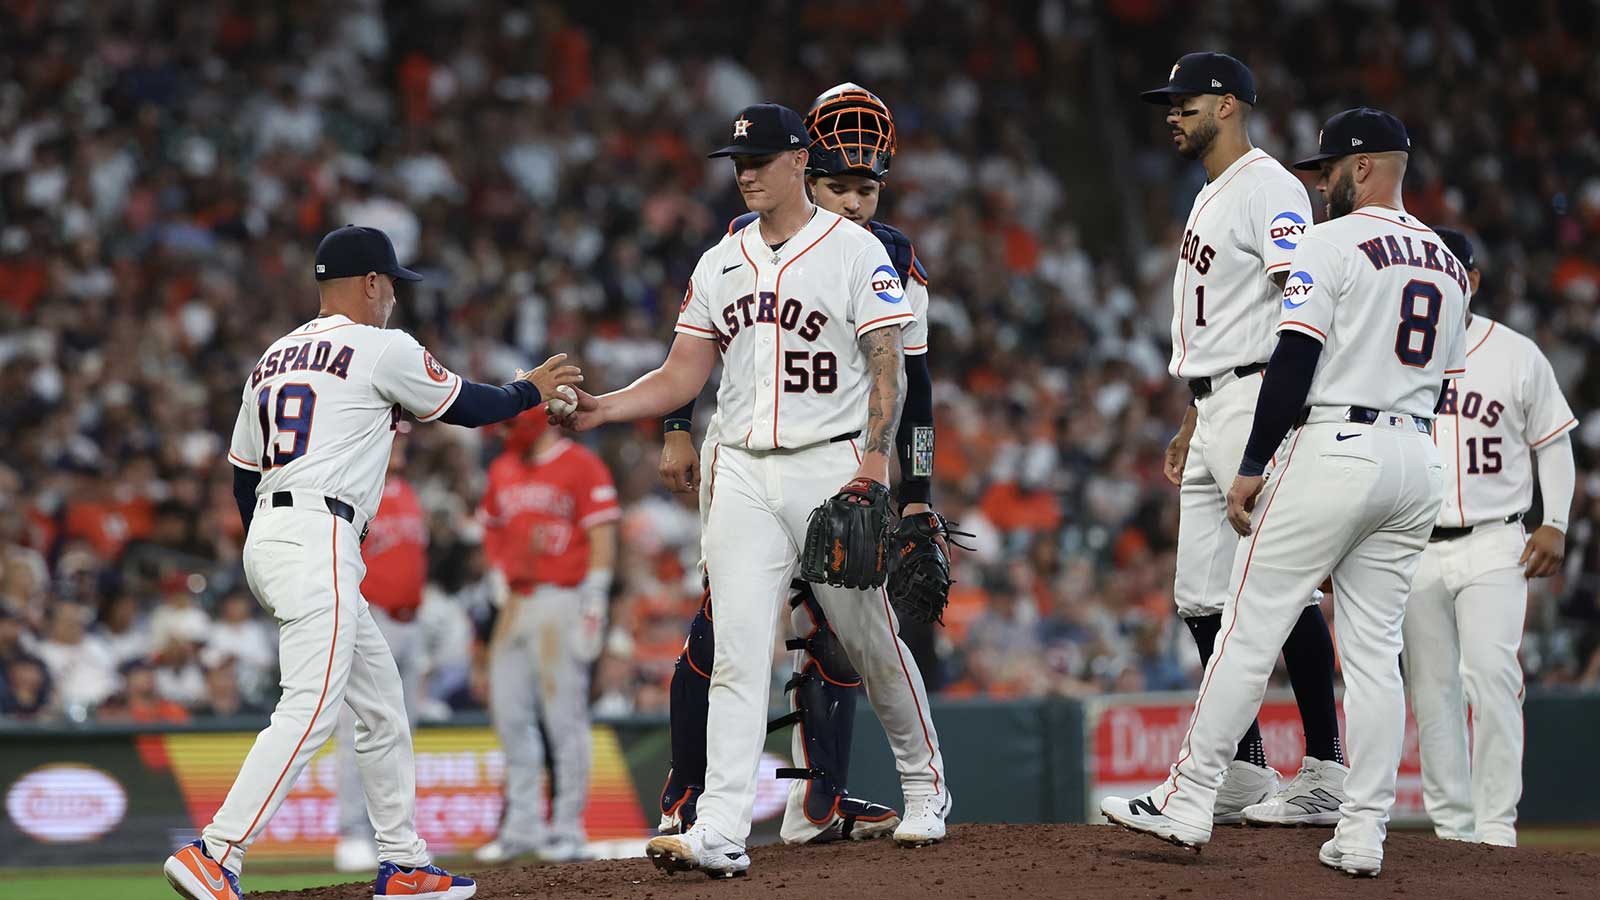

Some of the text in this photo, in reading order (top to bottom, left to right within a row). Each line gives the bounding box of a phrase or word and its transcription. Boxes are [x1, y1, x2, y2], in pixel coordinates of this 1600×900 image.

[1270, 225, 1307, 239] OXY
[872, 279, 900, 292] OXY
[1195, 284, 1207, 327] 1
[1283, 285, 1313, 298] OXY
[1394, 278, 1443, 369] 8
[251, 340, 355, 390] ESPADA
[783, 350, 838, 394] 58
[257, 382, 318, 472] 19
[1466, 437, 1502, 475] 15
